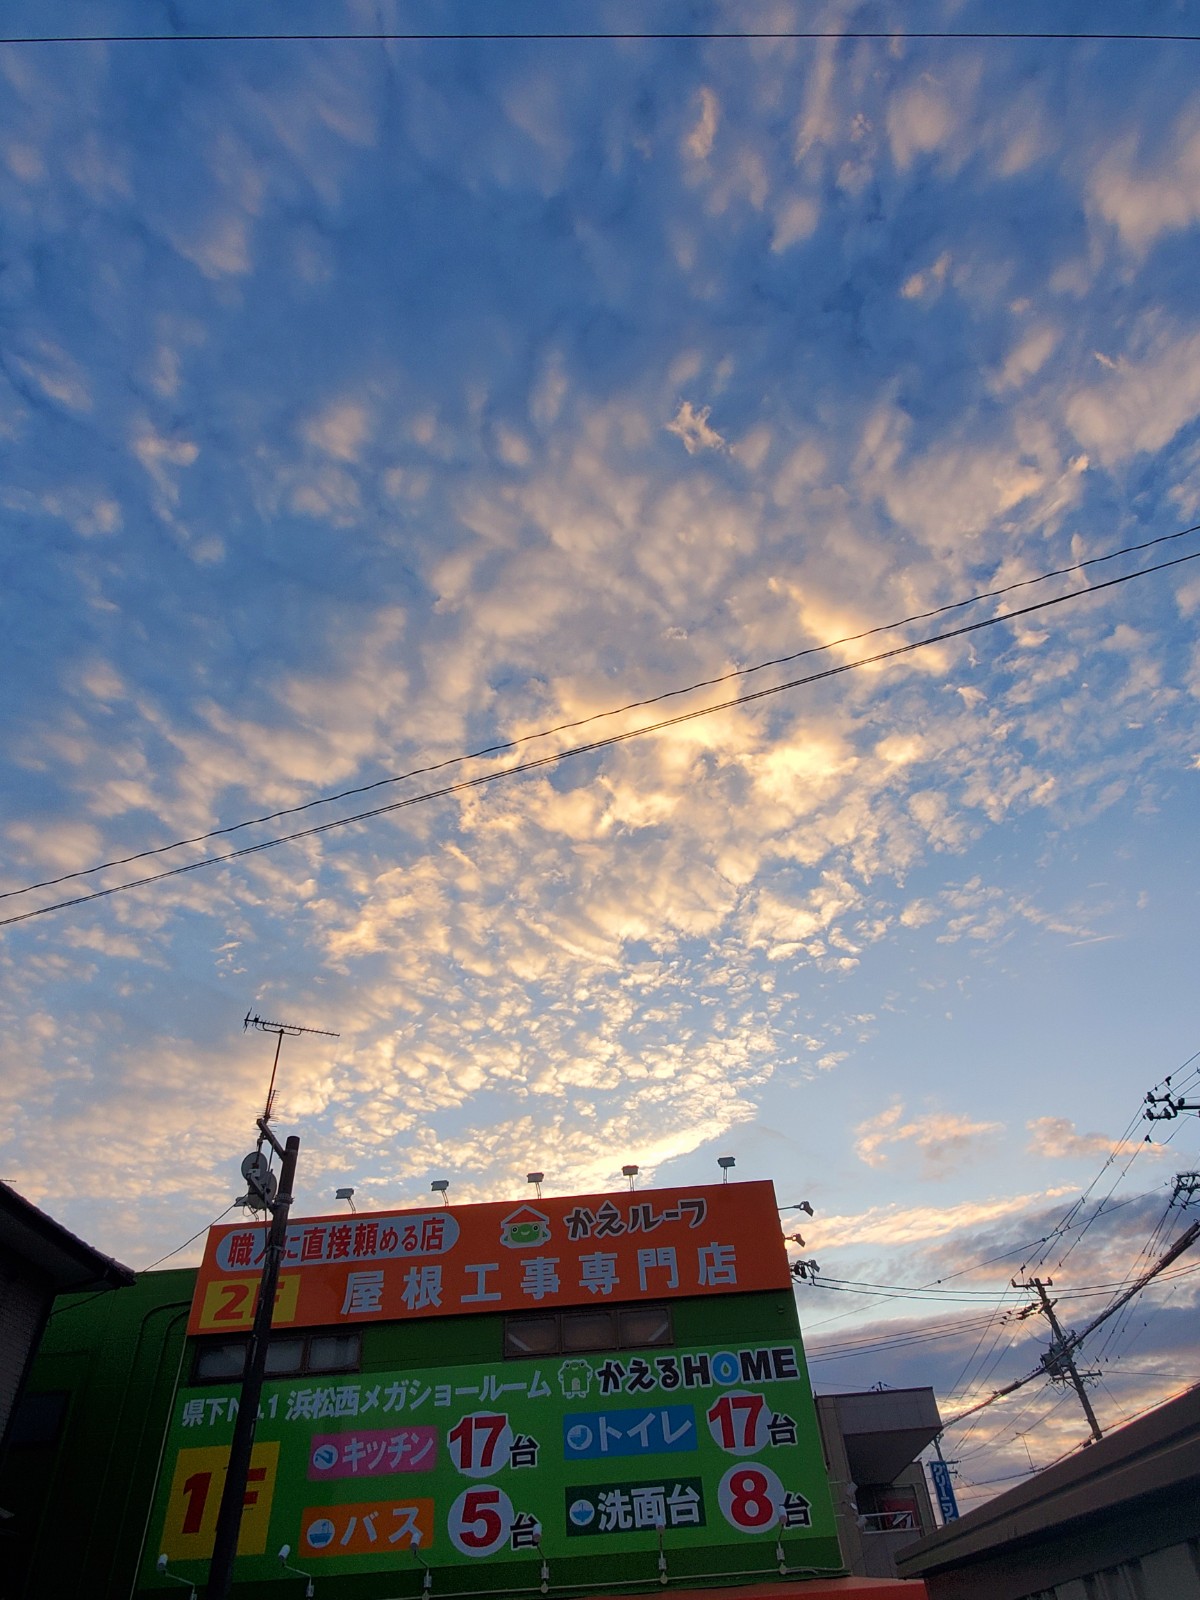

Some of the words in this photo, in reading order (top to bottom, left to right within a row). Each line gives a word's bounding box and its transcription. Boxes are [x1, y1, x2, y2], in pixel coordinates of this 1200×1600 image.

[340, 1242, 737, 1315] 屋根工事専門店
[182, 1394, 279, 1427] 県下N.1
[285, 1371, 552, 1420] 浜松西メガショールーム
[342, 1432, 434, 1472] キッチン
[600, 1410, 693, 1452] トイレ
[340, 1506, 423, 1546] バス
[597, 1484, 701, 1531] 洗面台
